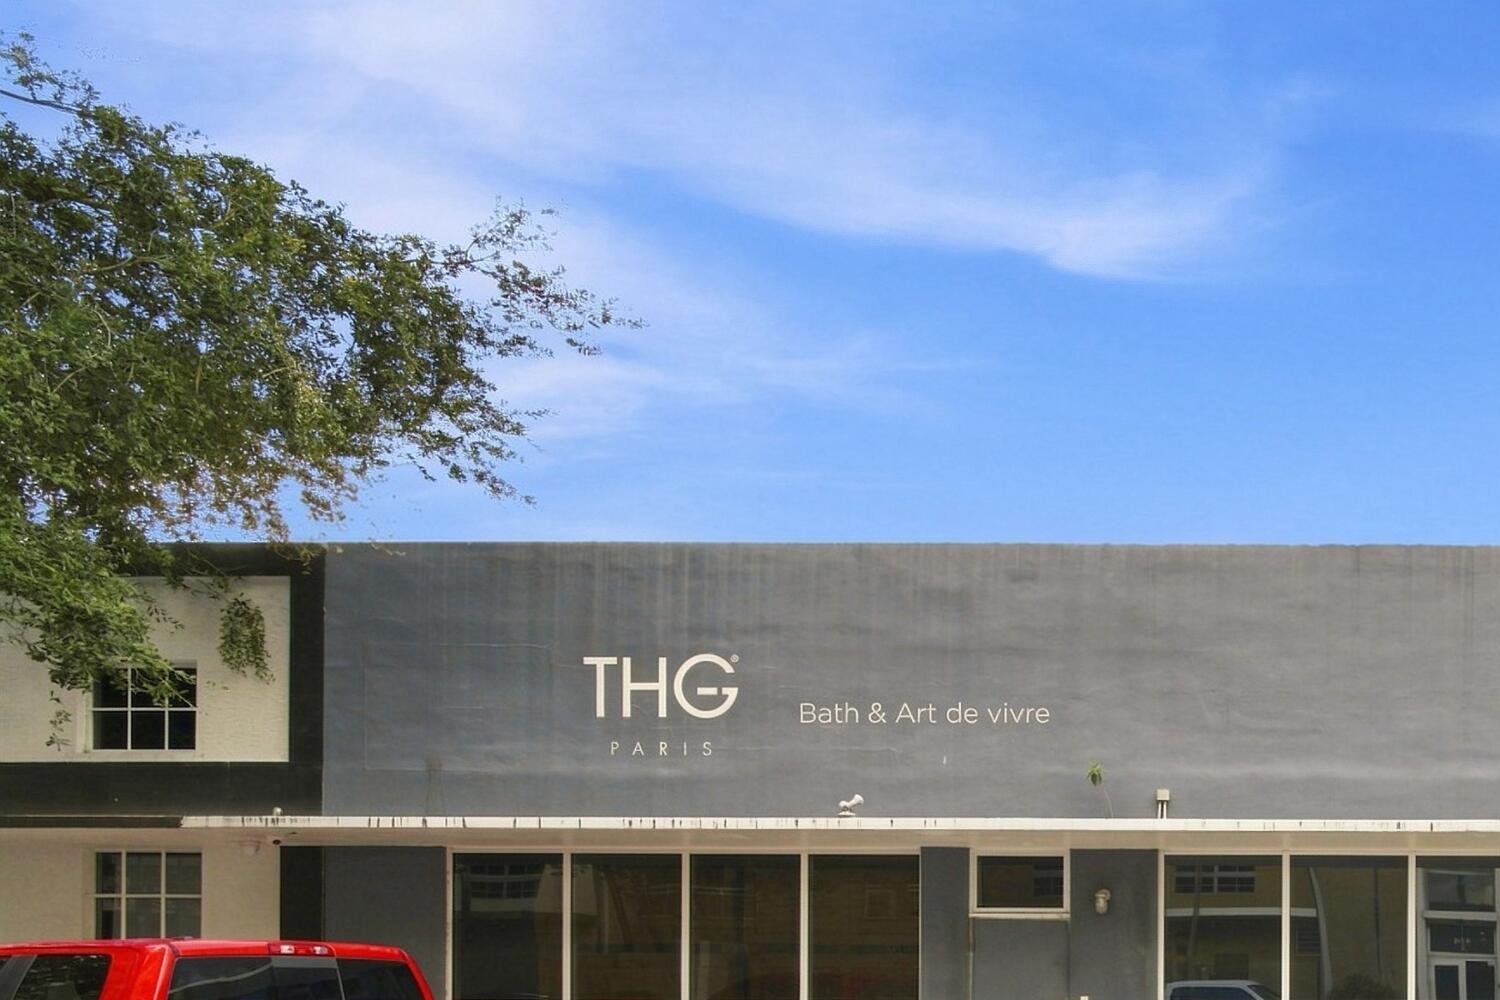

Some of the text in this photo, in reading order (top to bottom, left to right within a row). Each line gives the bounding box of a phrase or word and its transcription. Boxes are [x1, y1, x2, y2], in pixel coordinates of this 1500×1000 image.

[583, 653, 739, 719] THG
[799, 702, 1050, 724] Bath & Art de vivre
[610, 741, 713, 757] PARIS
